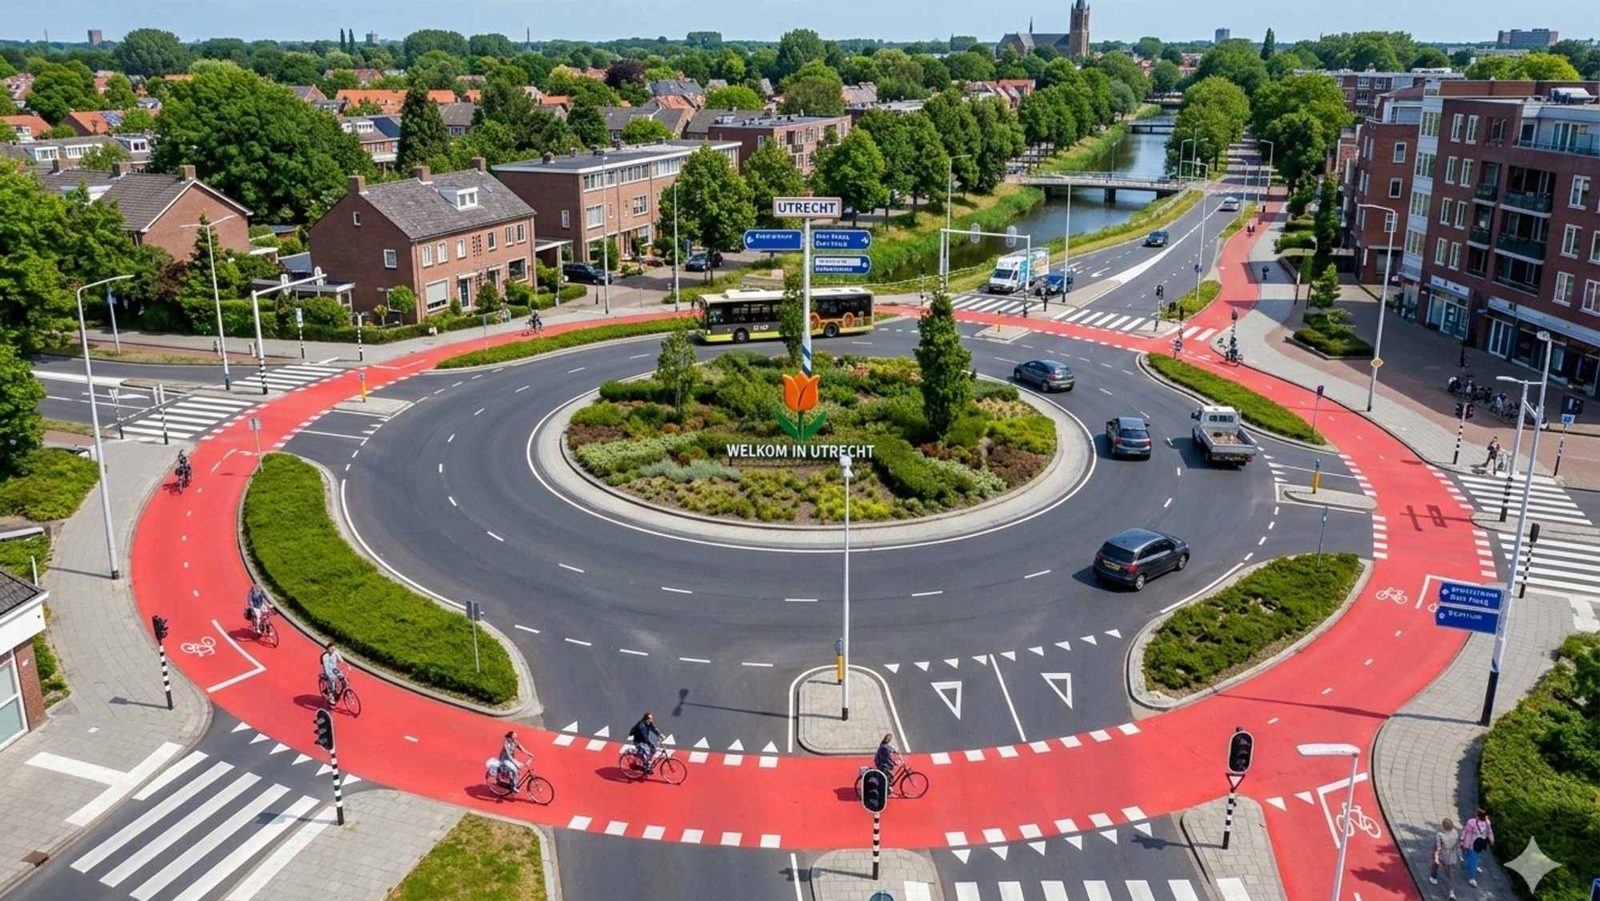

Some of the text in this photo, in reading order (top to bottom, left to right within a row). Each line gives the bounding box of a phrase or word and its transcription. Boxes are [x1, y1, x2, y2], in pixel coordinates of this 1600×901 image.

[778, 202, 836, 213] UTRECHT
[726, 444, 875, 458] WELKOM IN UTRECHT
